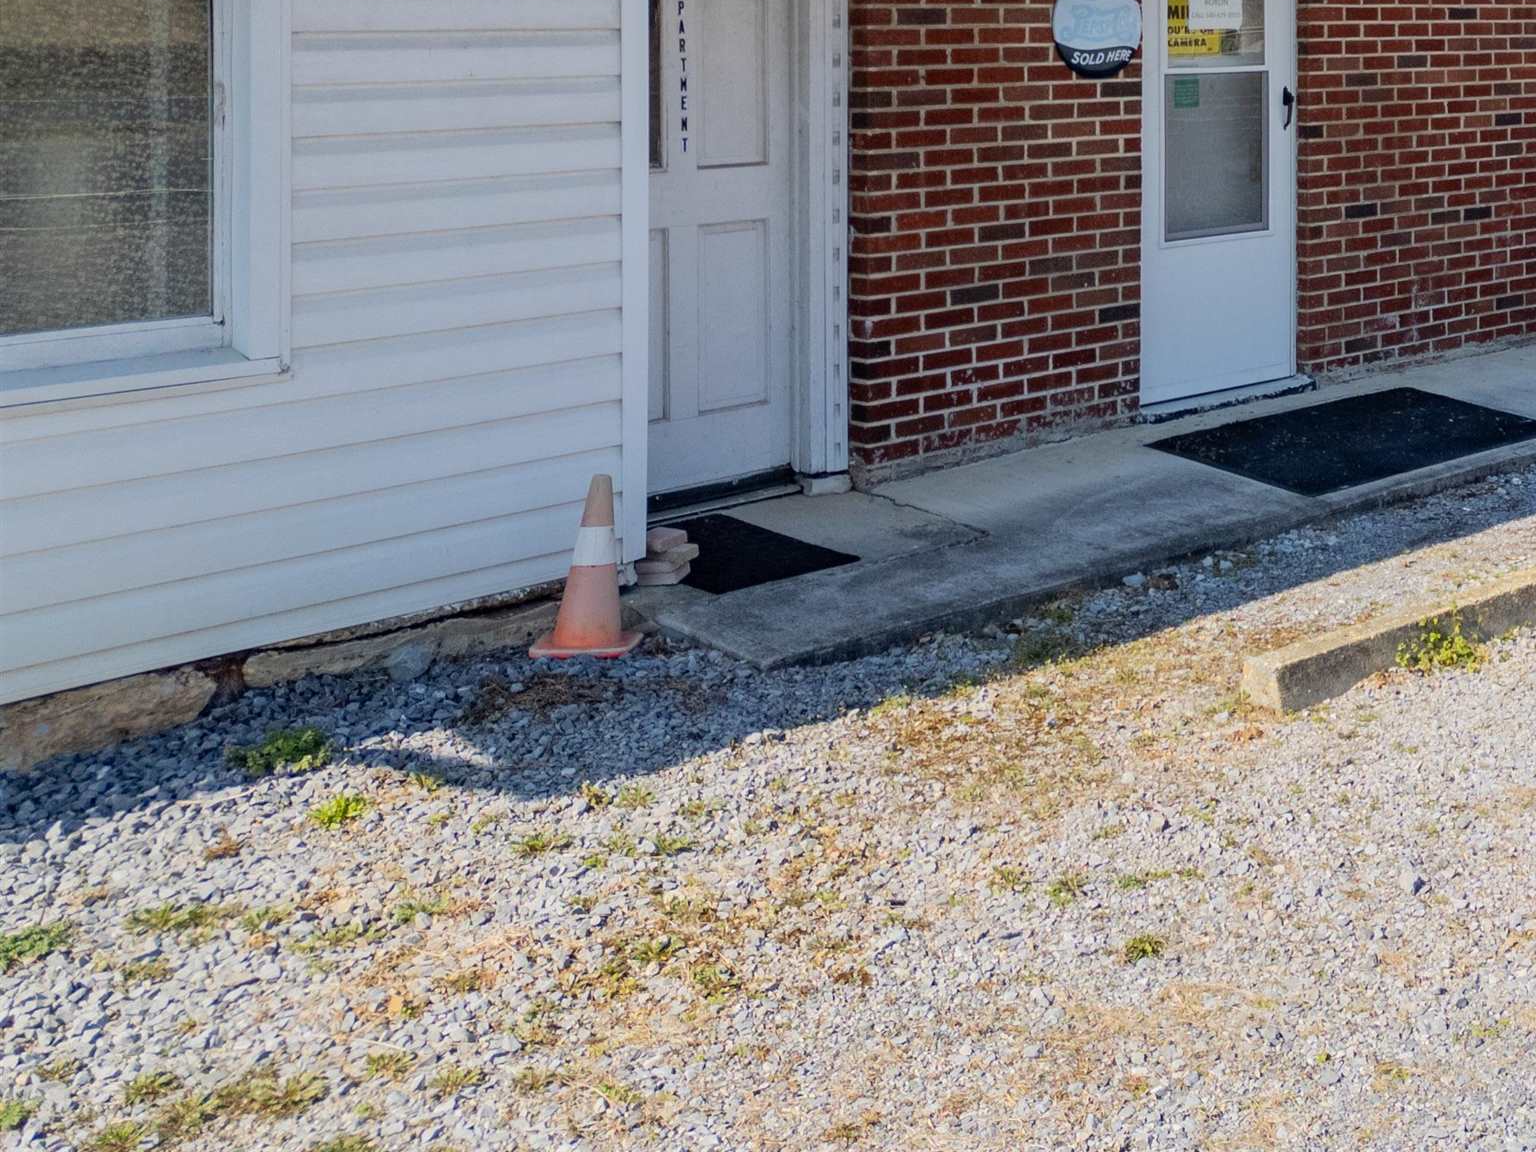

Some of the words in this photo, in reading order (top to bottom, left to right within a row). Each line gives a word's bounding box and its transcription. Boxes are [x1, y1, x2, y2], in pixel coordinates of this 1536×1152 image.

[1168, 38, 1207, 47] CAMERA
[1072, 51, 1104, 66] SOLD
[1106, 49, 1132, 64] HERE
